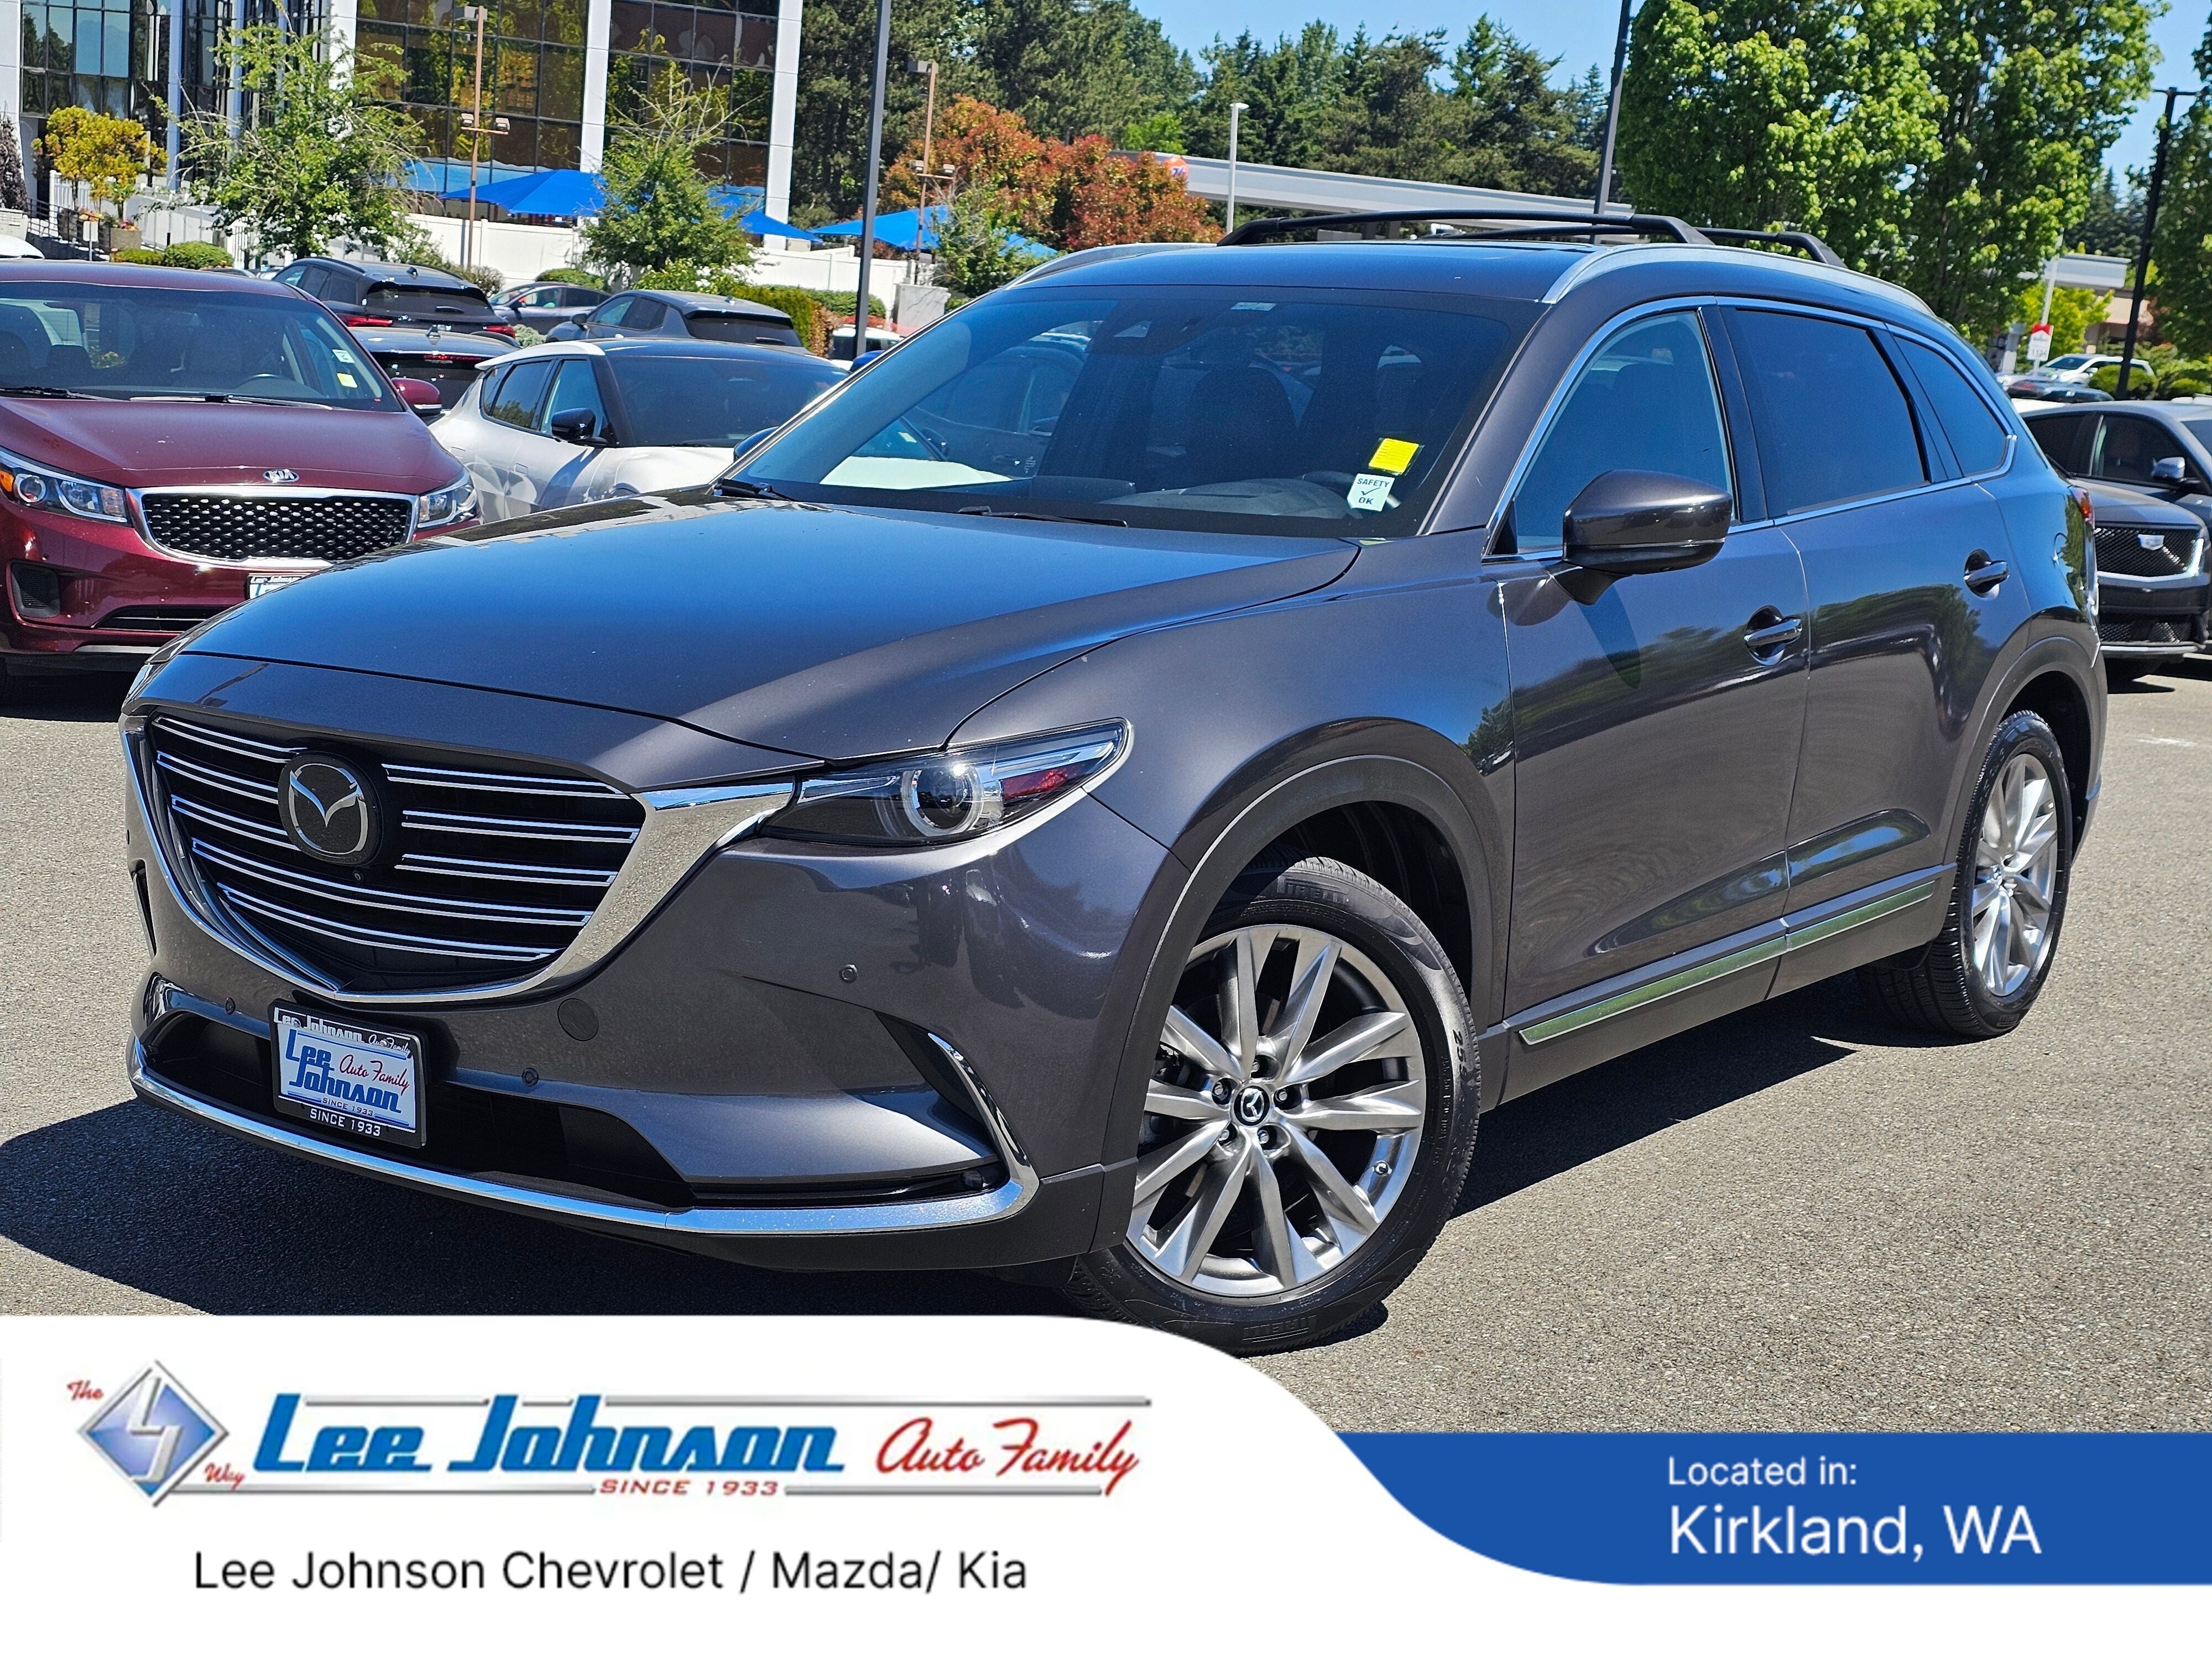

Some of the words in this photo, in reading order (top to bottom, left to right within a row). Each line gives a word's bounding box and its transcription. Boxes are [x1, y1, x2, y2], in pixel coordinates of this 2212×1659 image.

[268, 469, 295, 481] KIA
[1357, 478, 1390, 487] SAFETY
[303, 1015, 365, 1044] Johnson
[285, 1028, 335, 1068] Lee
[340, 1054, 369, 1078] Auto
[369, 1060, 410, 1096] Family
[289, 1059, 402, 1114] Johnson
[322, 1097, 348, 1110] SINCE
[352, 1105, 373, 1117] 1933
[310, 1108, 345, 1128] SINCE
[351, 1119, 381, 1136] 1933
